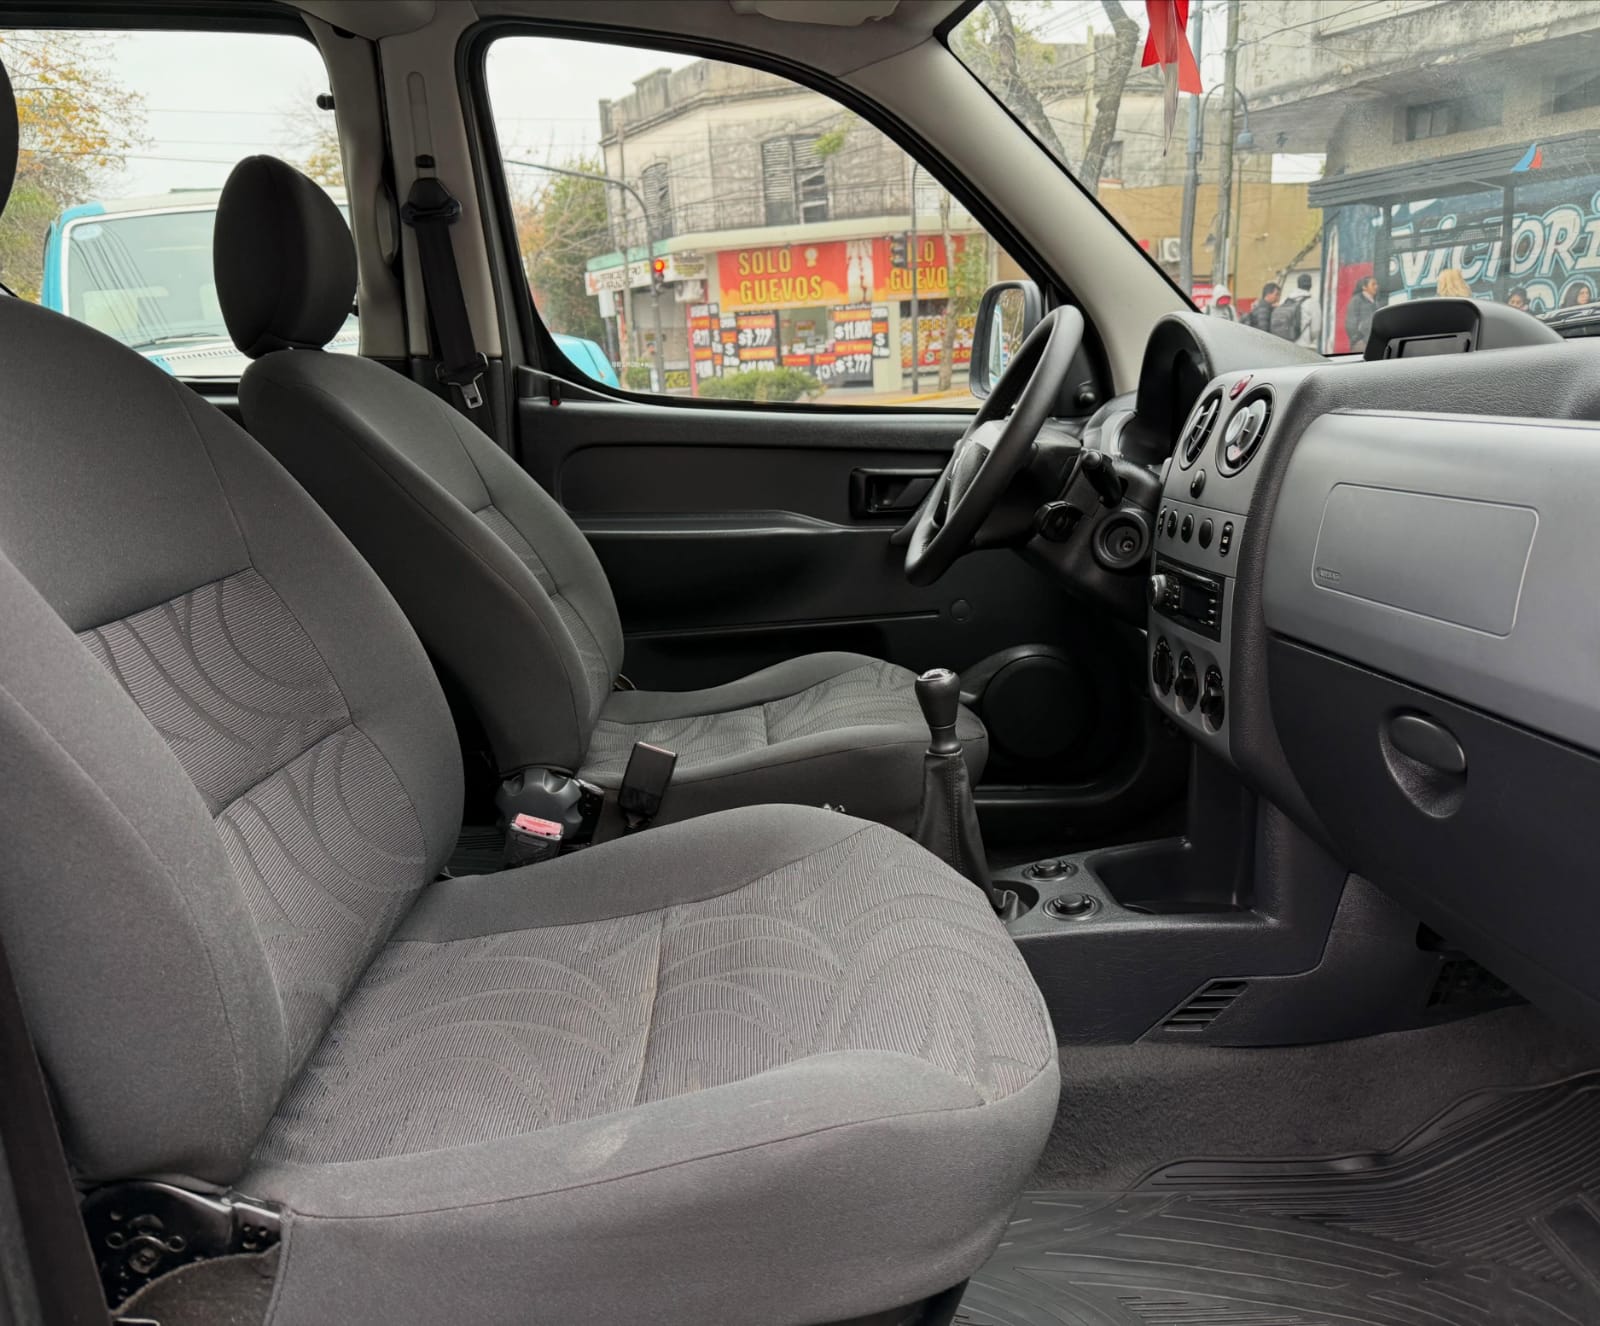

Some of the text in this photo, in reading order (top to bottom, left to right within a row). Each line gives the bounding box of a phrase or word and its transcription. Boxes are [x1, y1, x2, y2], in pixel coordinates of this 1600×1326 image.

[738, 248, 792, 276] SOLO
[739, 275, 823, 304] GUEVOS
[890, 266, 948, 290] GUEVO
